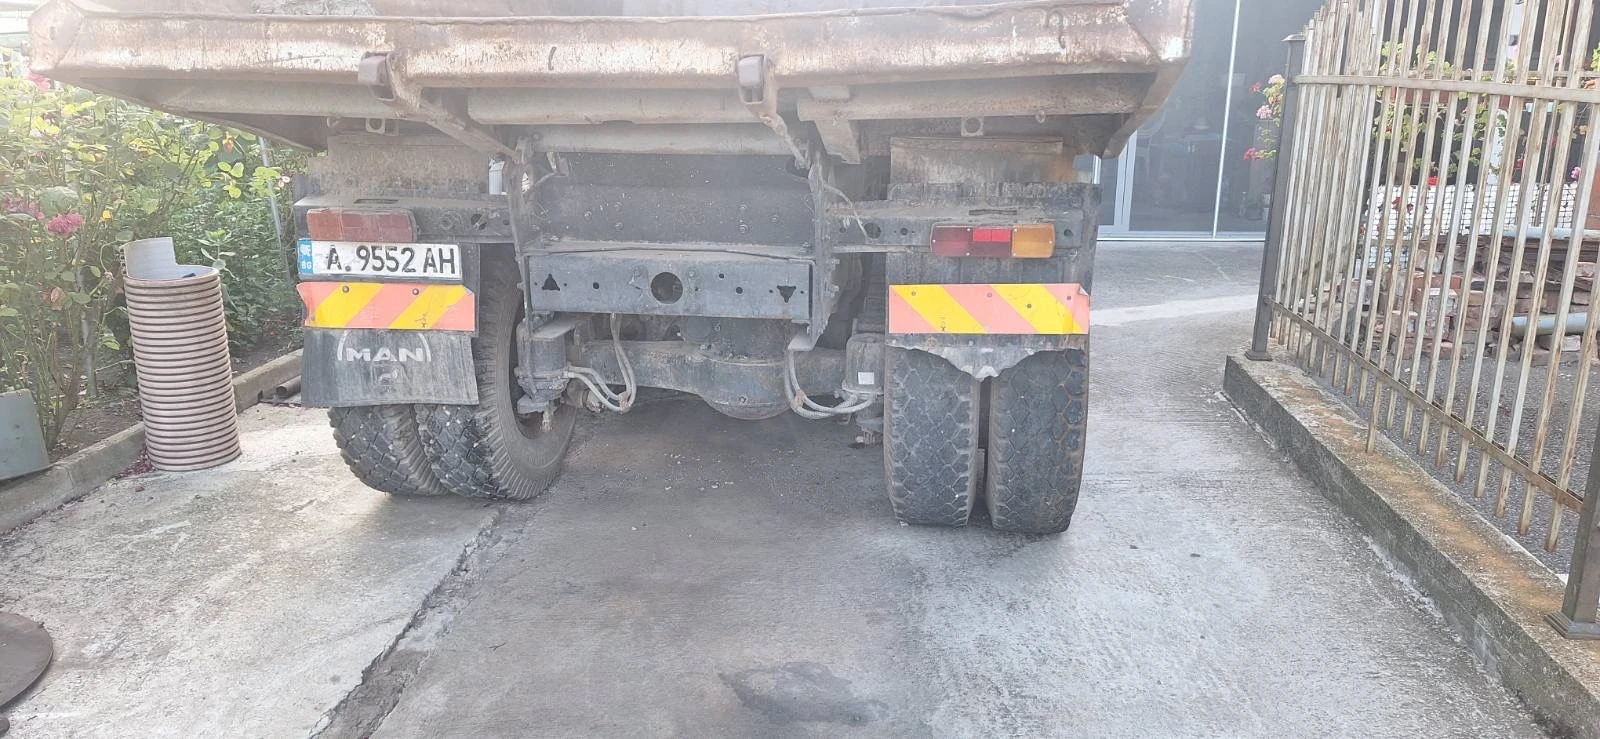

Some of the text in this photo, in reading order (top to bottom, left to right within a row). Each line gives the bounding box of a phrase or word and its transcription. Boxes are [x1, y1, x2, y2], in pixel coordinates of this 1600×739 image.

[301, 261, 312, 270] BG
[356, 245, 417, 273] 9552
[423, 248, 456, 275] AH
[345, 347, 424, 362] MAN
